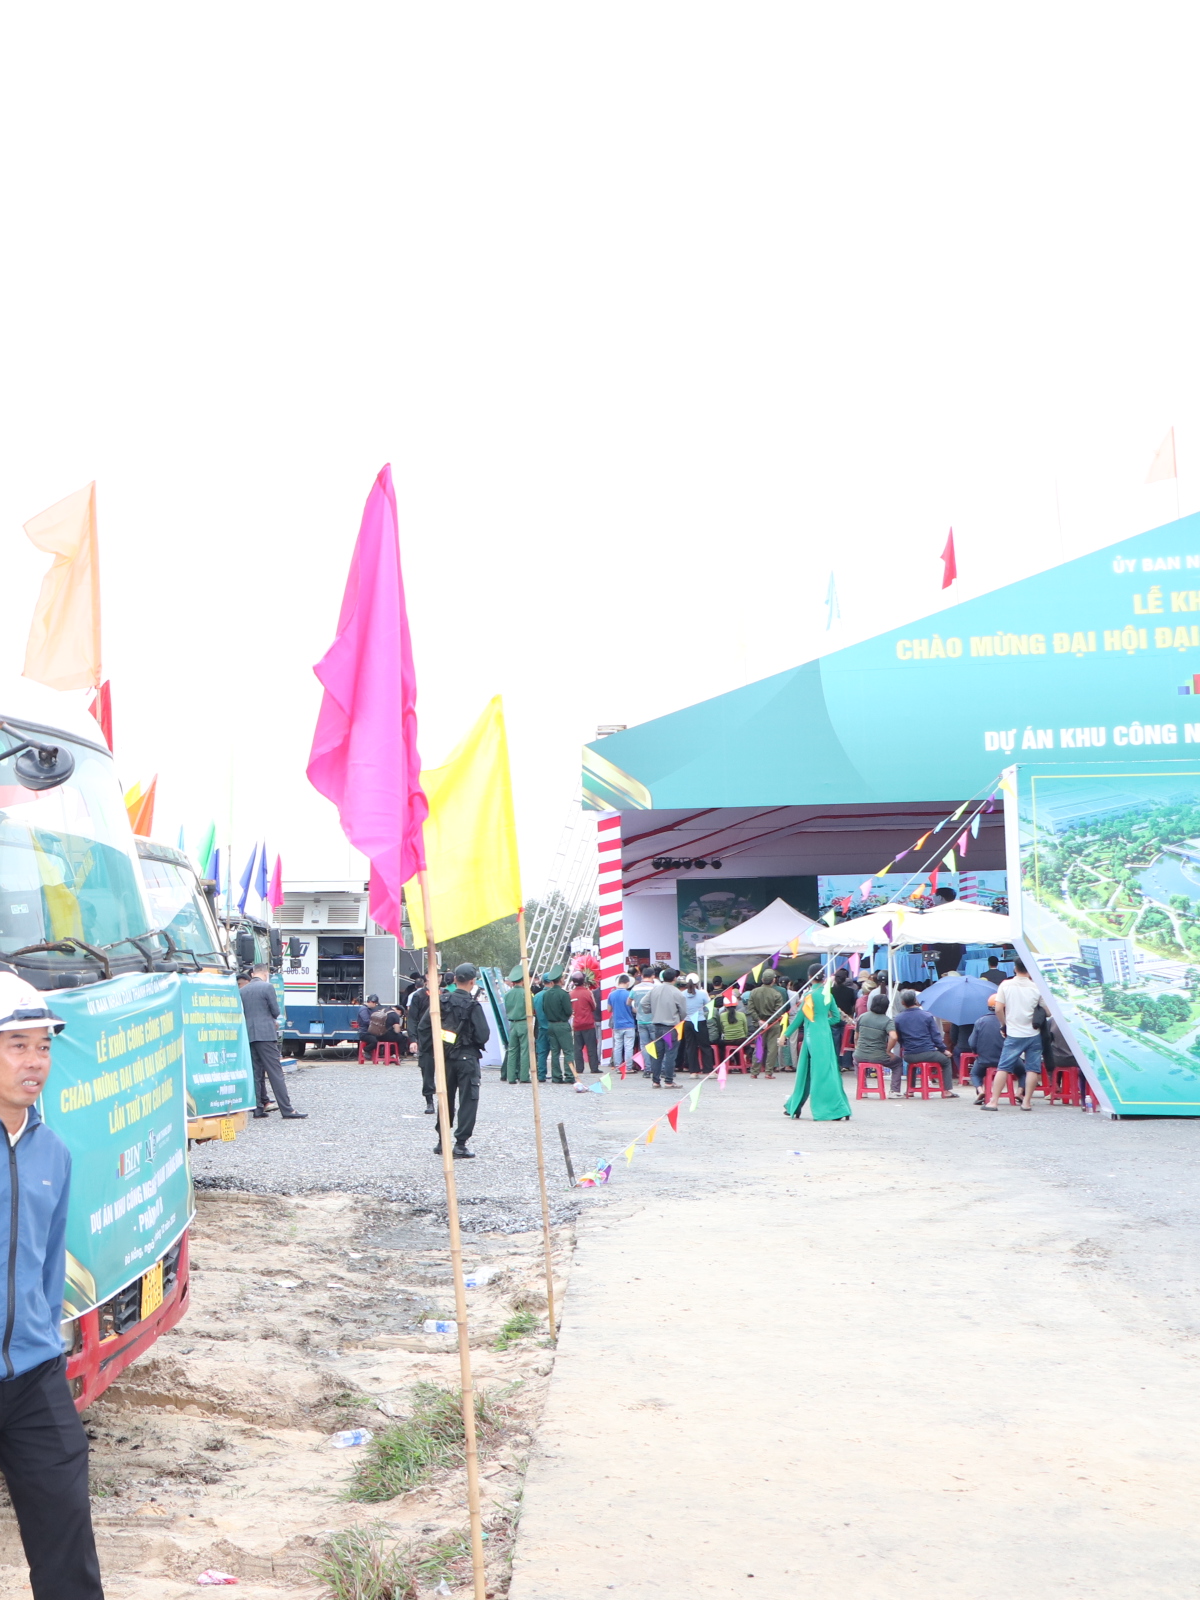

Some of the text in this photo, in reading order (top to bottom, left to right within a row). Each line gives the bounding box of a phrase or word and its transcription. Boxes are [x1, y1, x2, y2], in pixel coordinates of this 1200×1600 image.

[1113, 555, 1137, 574] ỦY
[1142, 556, 1181, 572] BAN
[1133, 585, 1164, 615] LỄ
[896, 624, 1200, 661] CHÀO MỪNG ĐẠI HỘI ĐẠI
[984, 728, 1017, 755] DỰ
[1021, 726, 1053, 750] ÁN
[1060, 726, 1106, 749] KHU
[1113, 721, 1178, 747] CÔNG
[96, 1030, 107, 1064] LỄ
[108, 1025, 126, 1059] KHỞI
[60, 1079, 93, 1114] CHÀO
[93, 1071, 120, 1102] MỪNG
[108, 1101, 126, 1135] LẦN
[124, 1142, 142, 1175] BIN
[90, 1208, 102, 1235] DỰ
[103, 1203, 114, 1228] ÁN
